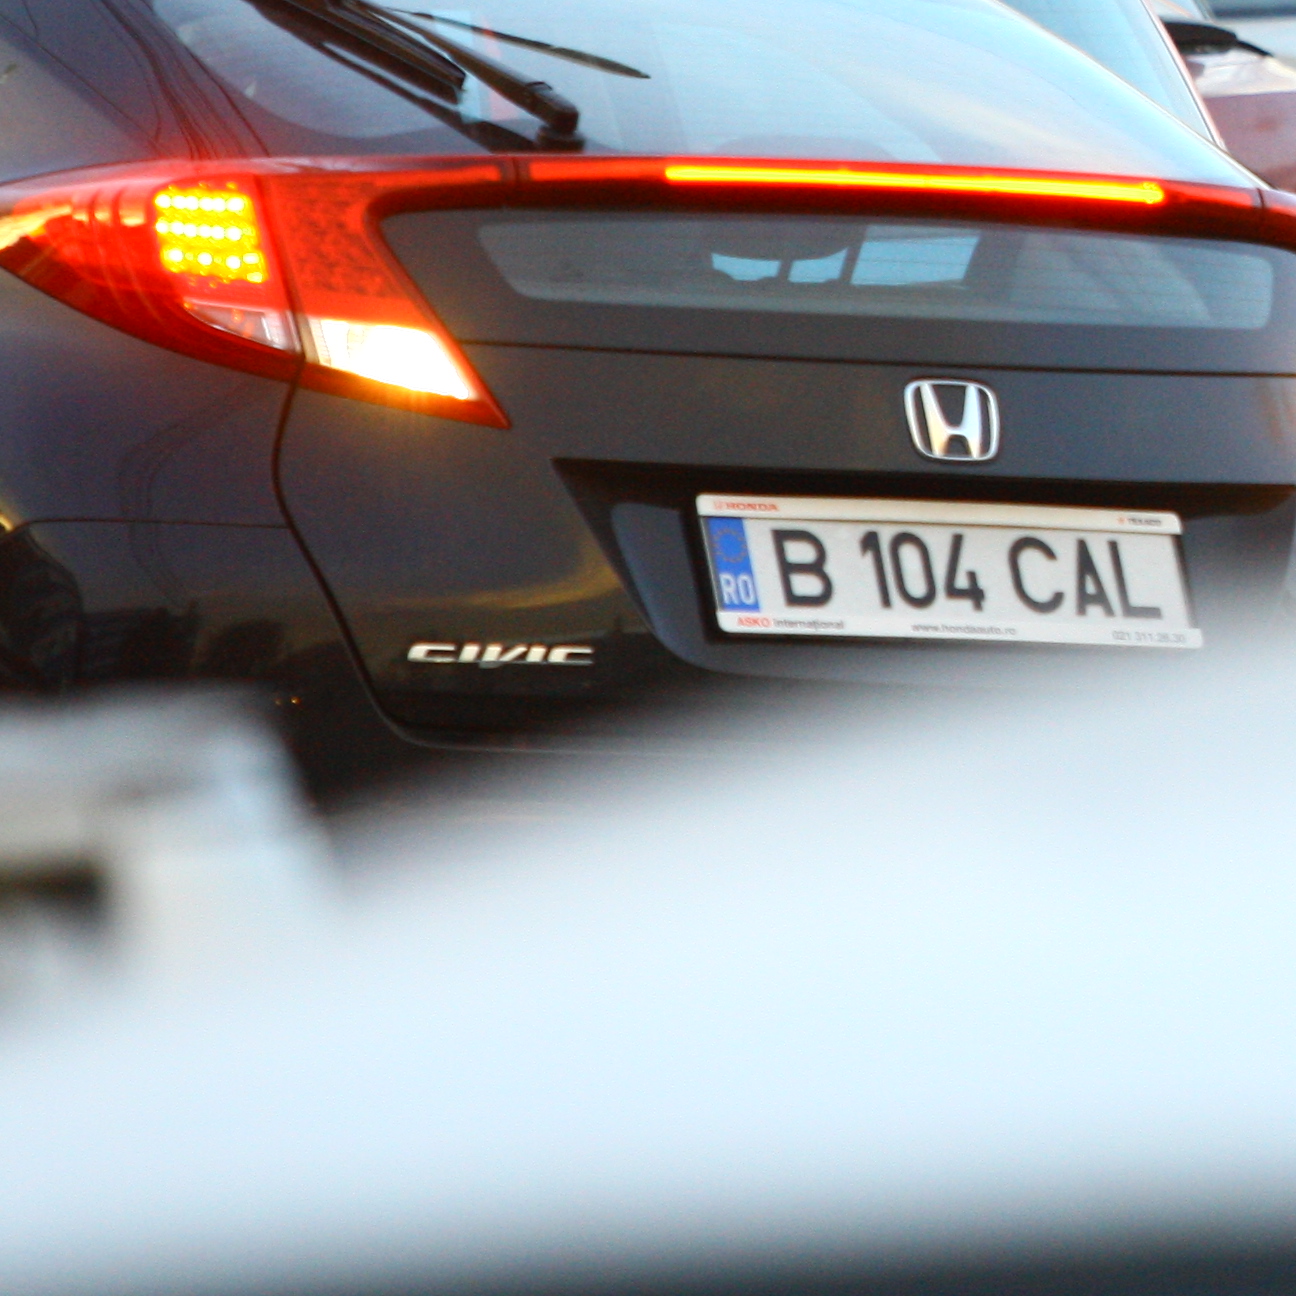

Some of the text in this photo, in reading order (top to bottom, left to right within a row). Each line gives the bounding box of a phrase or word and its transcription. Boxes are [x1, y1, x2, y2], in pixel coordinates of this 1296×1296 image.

[725, 502, 779, 512] HONDA
[771, 529, 1163, 619] B 104 CAL
[719, 571, 757, 606] RO
[736, 616, 772, 628] ASKO
[407, 642, 595, 666] CIVIC
